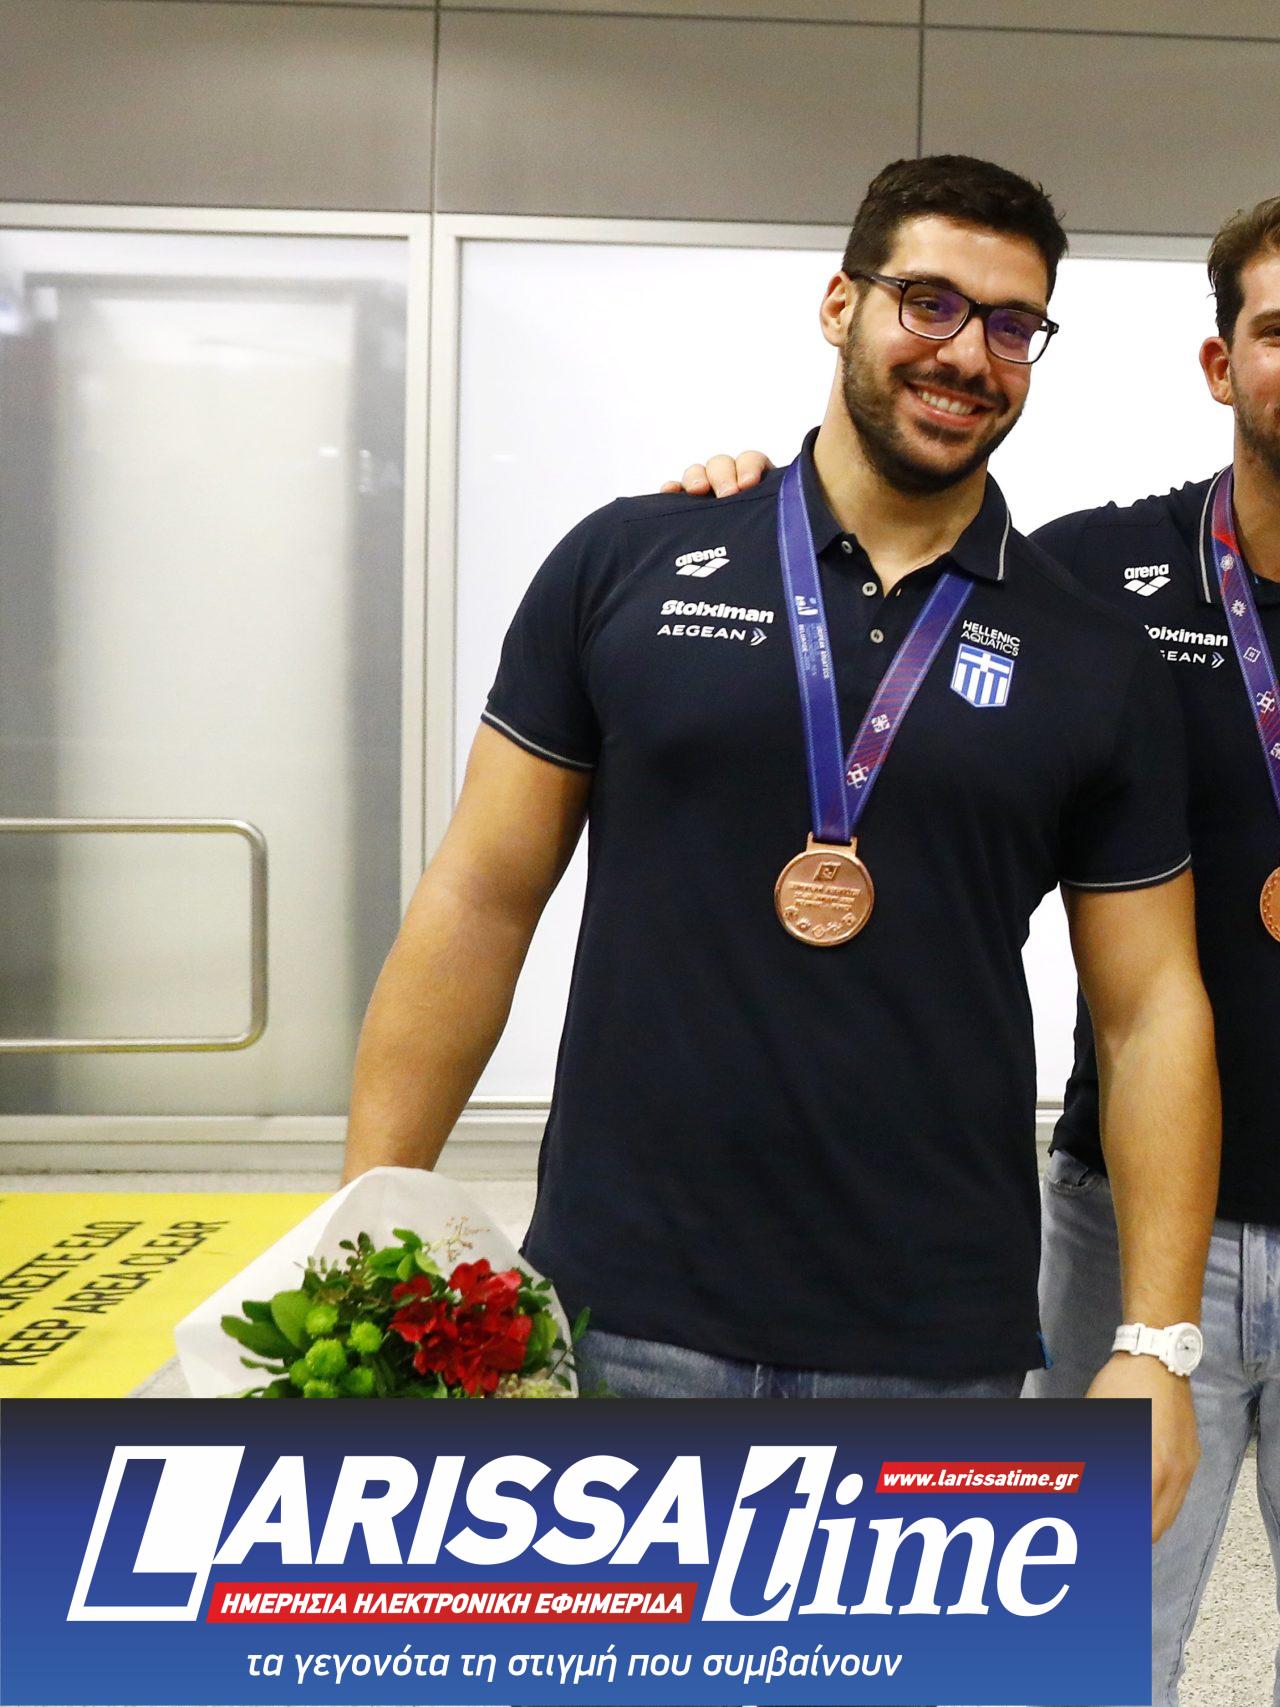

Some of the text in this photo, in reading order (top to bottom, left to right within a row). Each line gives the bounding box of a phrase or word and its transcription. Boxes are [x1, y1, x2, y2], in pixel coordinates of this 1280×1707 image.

[675, 546, 727, 567] arena
[1124, 563, 1170, 580] arena
[660, 599, 775, 624] Stoiximan
[656, 624, 747, 641] AEGEAN
[960, 630, 1020, 657] AQUATICS
[962, 619, 1021, 647] HELLENIC
[1143, 624, 1229, 647] oiximan
[1159, 649, 1207, 664] EAN
[0, 1220, 231, 1367] KEEP AREA CLEAR
